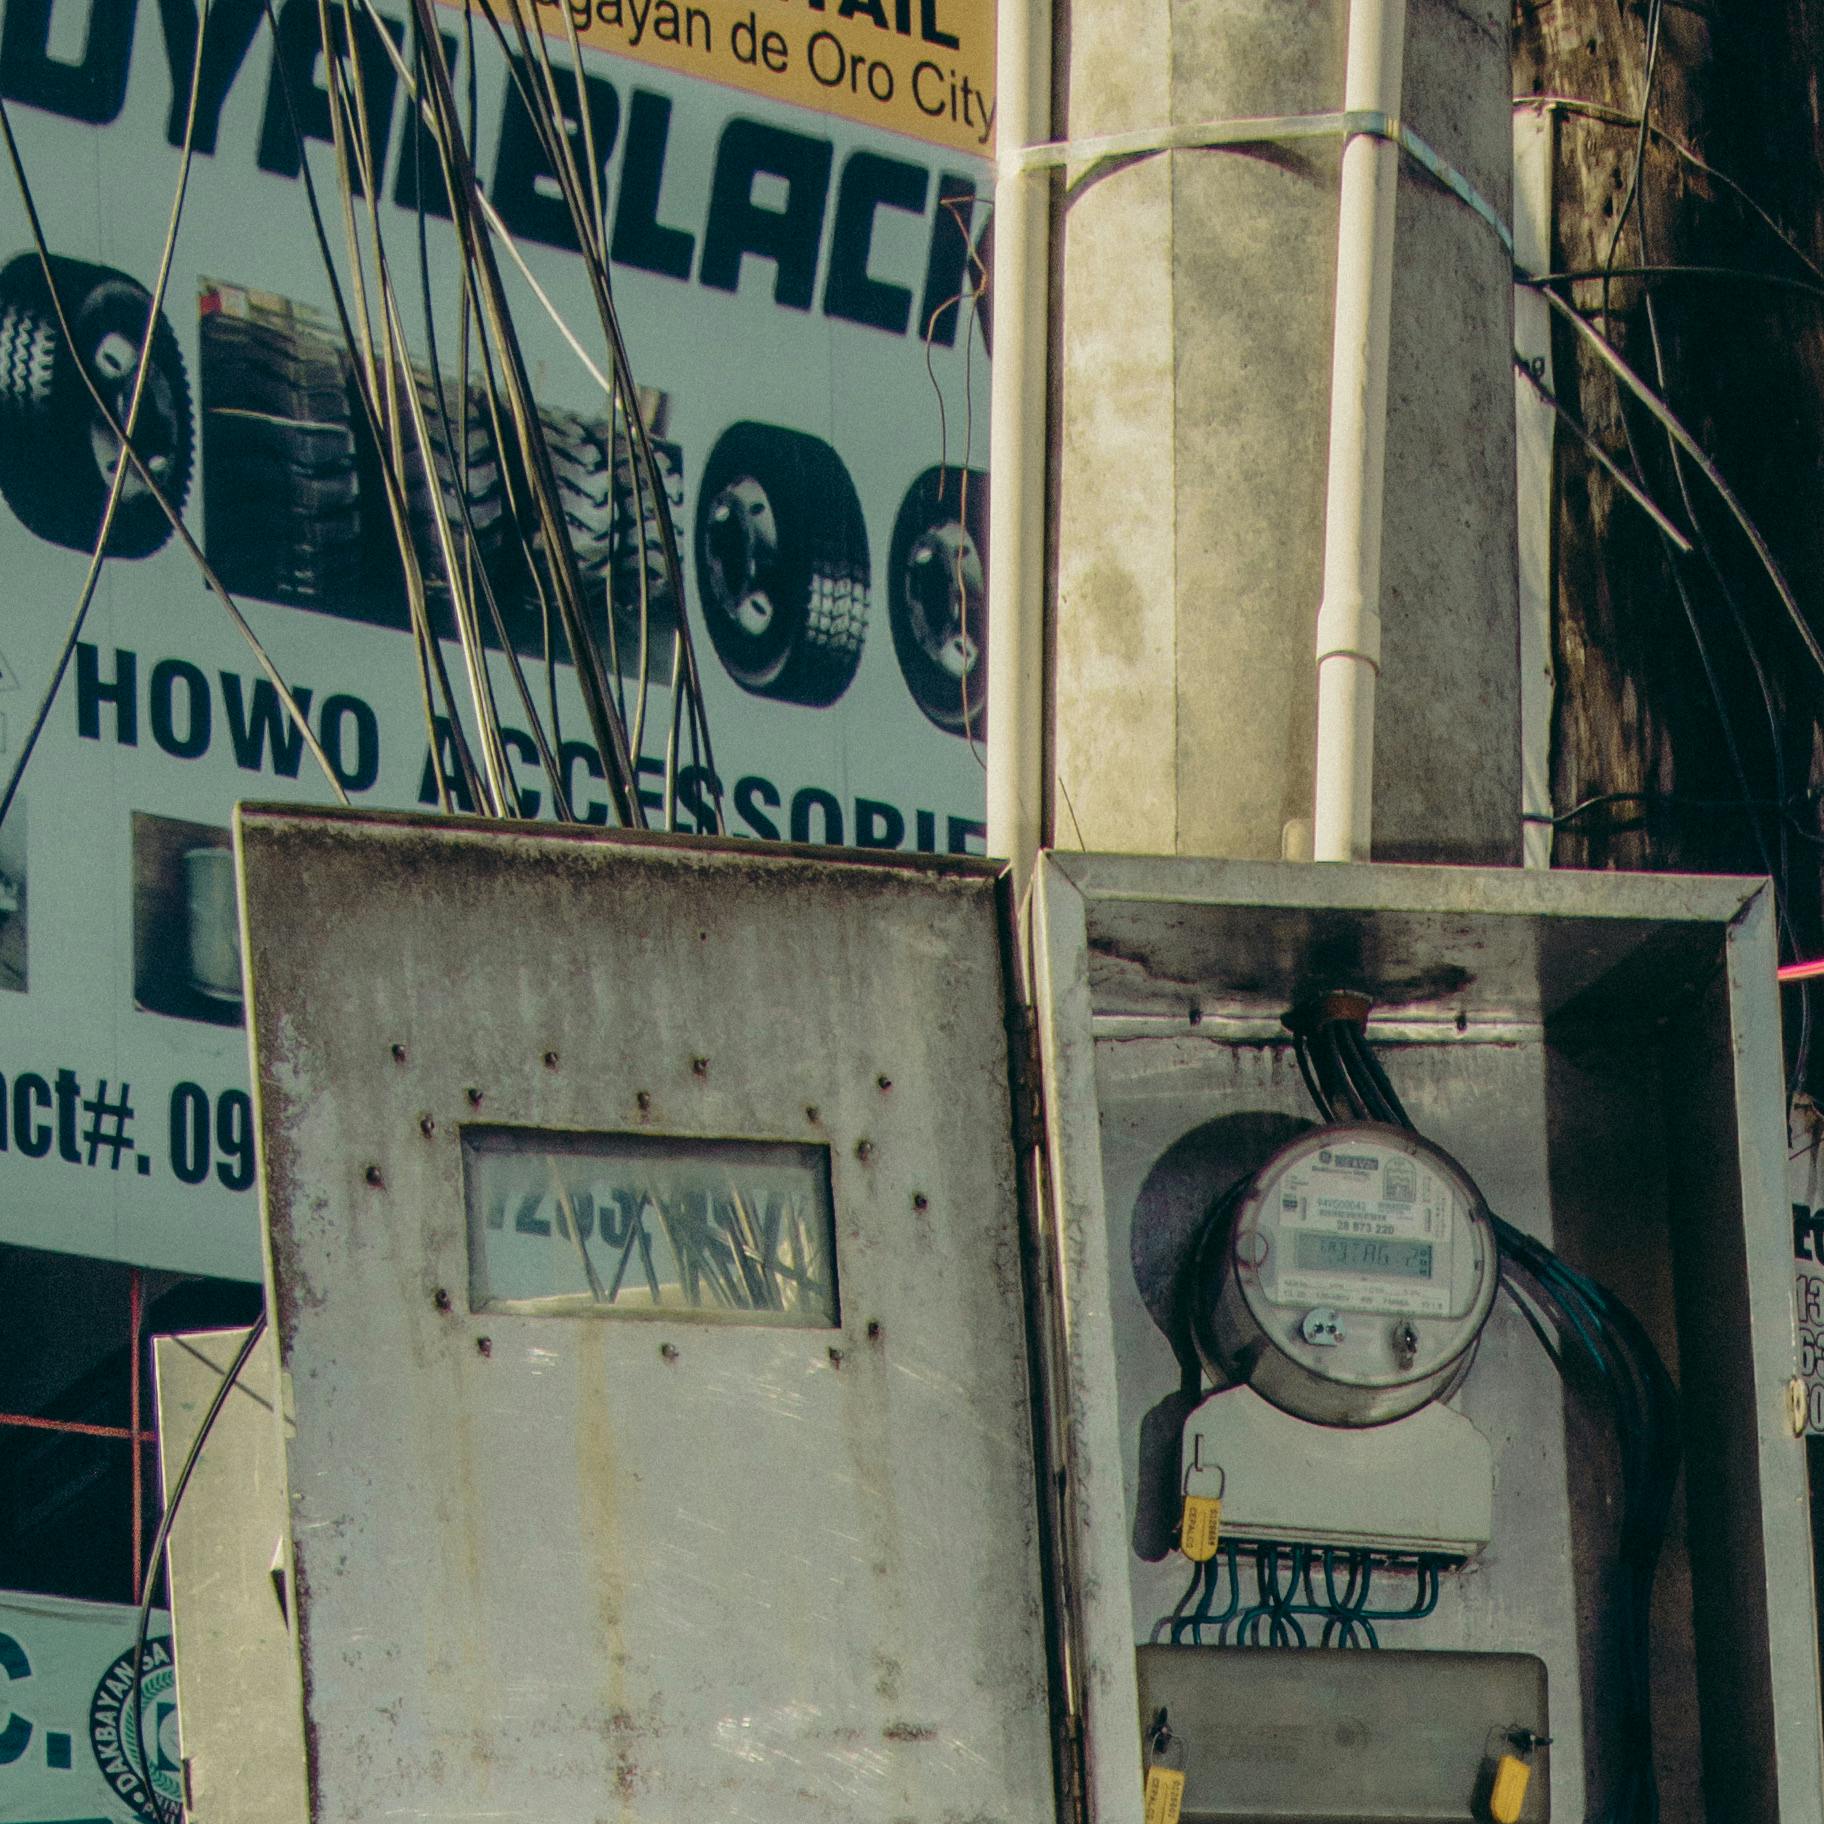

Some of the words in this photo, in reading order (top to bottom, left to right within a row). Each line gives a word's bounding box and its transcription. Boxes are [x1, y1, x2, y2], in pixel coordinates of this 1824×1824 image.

[731, 12, 789, 73] de
[807, 30, 895, 103] Oro
[911, 60, 996, 145] City
[76, 641, 380, 794] HOWO
